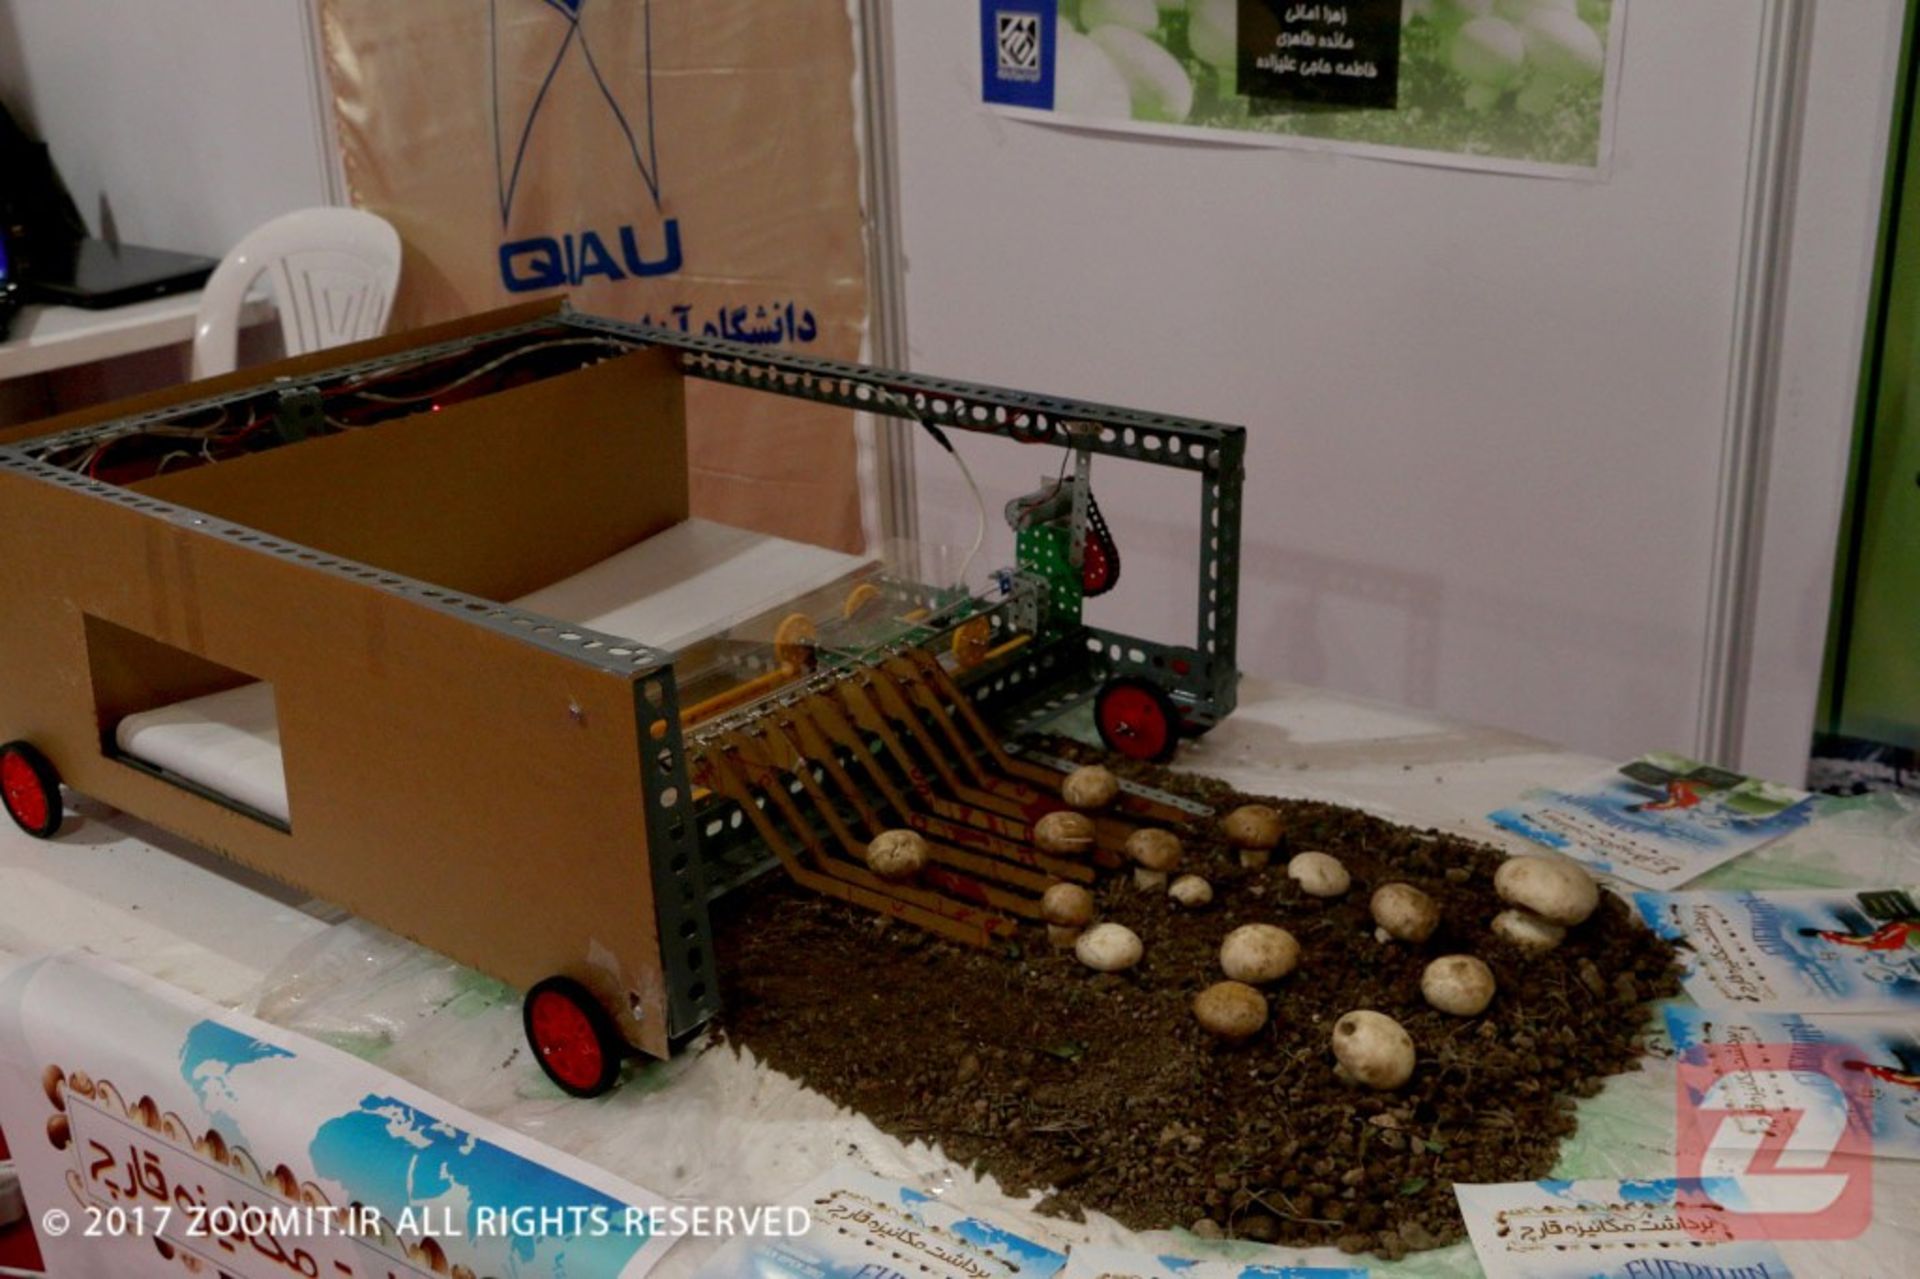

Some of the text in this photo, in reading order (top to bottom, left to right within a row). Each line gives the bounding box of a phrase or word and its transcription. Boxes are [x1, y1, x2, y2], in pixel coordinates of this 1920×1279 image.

[498, 219, 683, 293] QIAU
[703, 301, 818, 345] دانشگاه
[88, 1138, 169, 1200] قارچ
[828, 1204, 875, 1224] قارچ
[1564, 1217, 1636, 1239] مکانیزه
[867, 1220, 927, 1249] مکانیزه
[1519, 1220, 1562, 1242] قارچ
